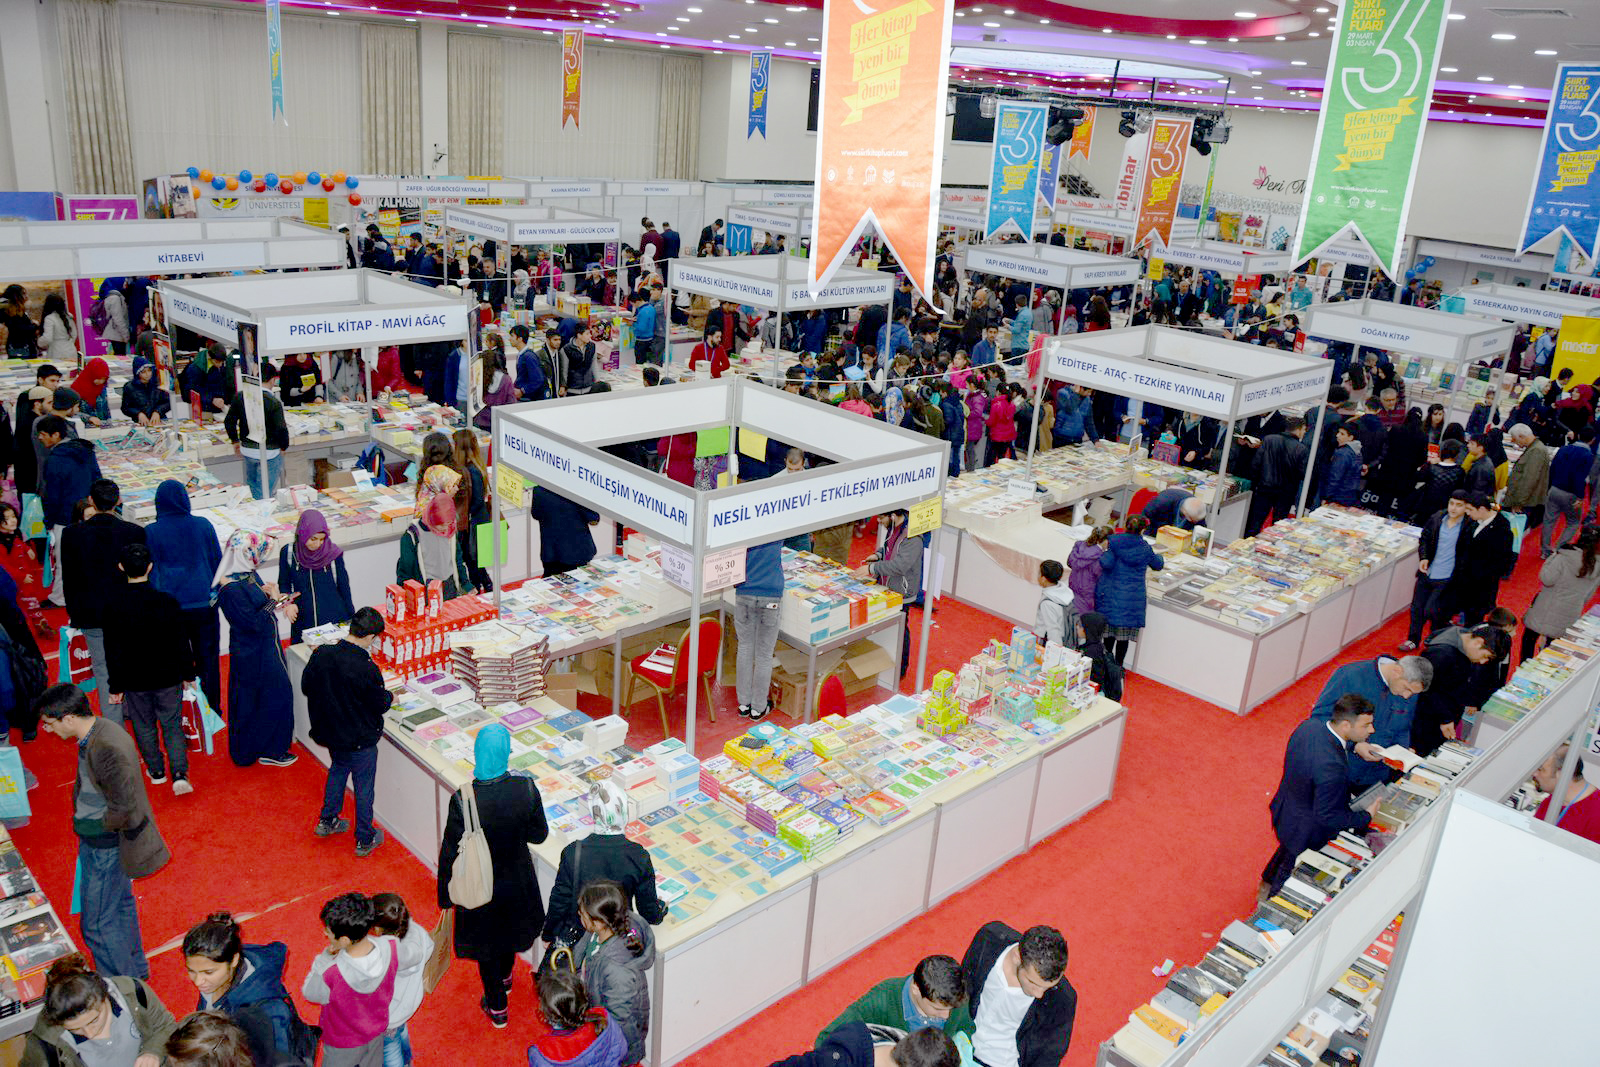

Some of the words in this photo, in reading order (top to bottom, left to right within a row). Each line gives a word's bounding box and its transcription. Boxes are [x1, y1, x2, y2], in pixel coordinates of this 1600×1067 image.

[854, 21, 879, 50] Her
[881, 13, 912, 38] kitap
[1347, 32, 1356, 40] 29
[1356, 32, 1374, 40] MART
[857, 48, 883, 77] yeni
[886, 42, 904, 63] bir
[861, 79, 897, 100] dünya
[1348, 113, 1367, 126] Her
[1369, 113, 1398, 124] kitap
[1350, 132, 1371, 143] yeni
[1373, 127, 1389, 139] bir
[1257, 174, 1285, 192] Peri
[569, 227, 596, 235] GÜLÜCÜK
[597, 227, 615, 236] ÇOCUK
[158, 251, 204, 263] KİTABEVİ
[1173, 250, 1196, 259] EVEREST
[1200, 254, 1213, 262] KAPI
[1213, 256, 1242, 267] YAYINLARI
[985, 257, 998, 266] YAPI
[999, 259, 1017, 270] KREDİ
[1017, 263, 1049, 275] YAYINLARI
[1106, 270, 1127, 278] YAYINLARI
[679, 270, 685, 280] İŞ
[685, 273, 713, 286] BANKASI
[713, 278, 738, 290] KÜLTÜR
[738, 283, 773, 298] YAYINLARI
[829, 285, 854, 297] KÜLTÜR
[855, 285, 887, 295] YAYINLARI
[173, 298, 192, 315] PROFİL
[192, 304, 208, 320] KİTAP
[210, 312, 226, 328] MAVİ
[1473, 299, 1518, 313] SEMERKAND
[1519, 306, 1542, 316] YAYIN
[290, 321, 335, 336] PROFİL
[338, 319, 373, 333] KİTAP
[382, 315, 413, 330] MAVİ
[415, 314, 447, 328] AĞAÇ
[1361, 326, 1389, 339] DOĞAN
[1389, 331, 1410, 342] KİTAP
[1561, 339, 1600, 355] mostar
[1056, 355, 1098, 374] YEDİTEPE
[1103, 367, 1127, 382] ATAÇ
[1134, 373, 1172, 391] TEZKİRE
[1174, 383, 1226, 404] YAYINLARI
[1244, 388, 1268, 402] YEDİTEPE
[1270, 386, 1283, 397] ATAÇ
[1286, 380, 1303, 393] TEZKİRE
[1303, 376, 1326, 388] YAYINLARI
[504, 433, 529, 450] NESİL
[530, 444, 571, 475] YAYINEVİ
[578, 466, 630, 500] ETKİLEŞİM
[632, 489, 688, 527] YAYINLARI
[713, 504, 751, 528] NESİL
[754, 490, 812, 519] YAYINEVİ
[820, 477, 879, 503] ETKİLEŞİM
[882, 466, 936, 489] YAYINLARI
[677, 560, 686, 572] 30
[714, 563, 724, 574] %
[725, 559, 735, 570] 30
